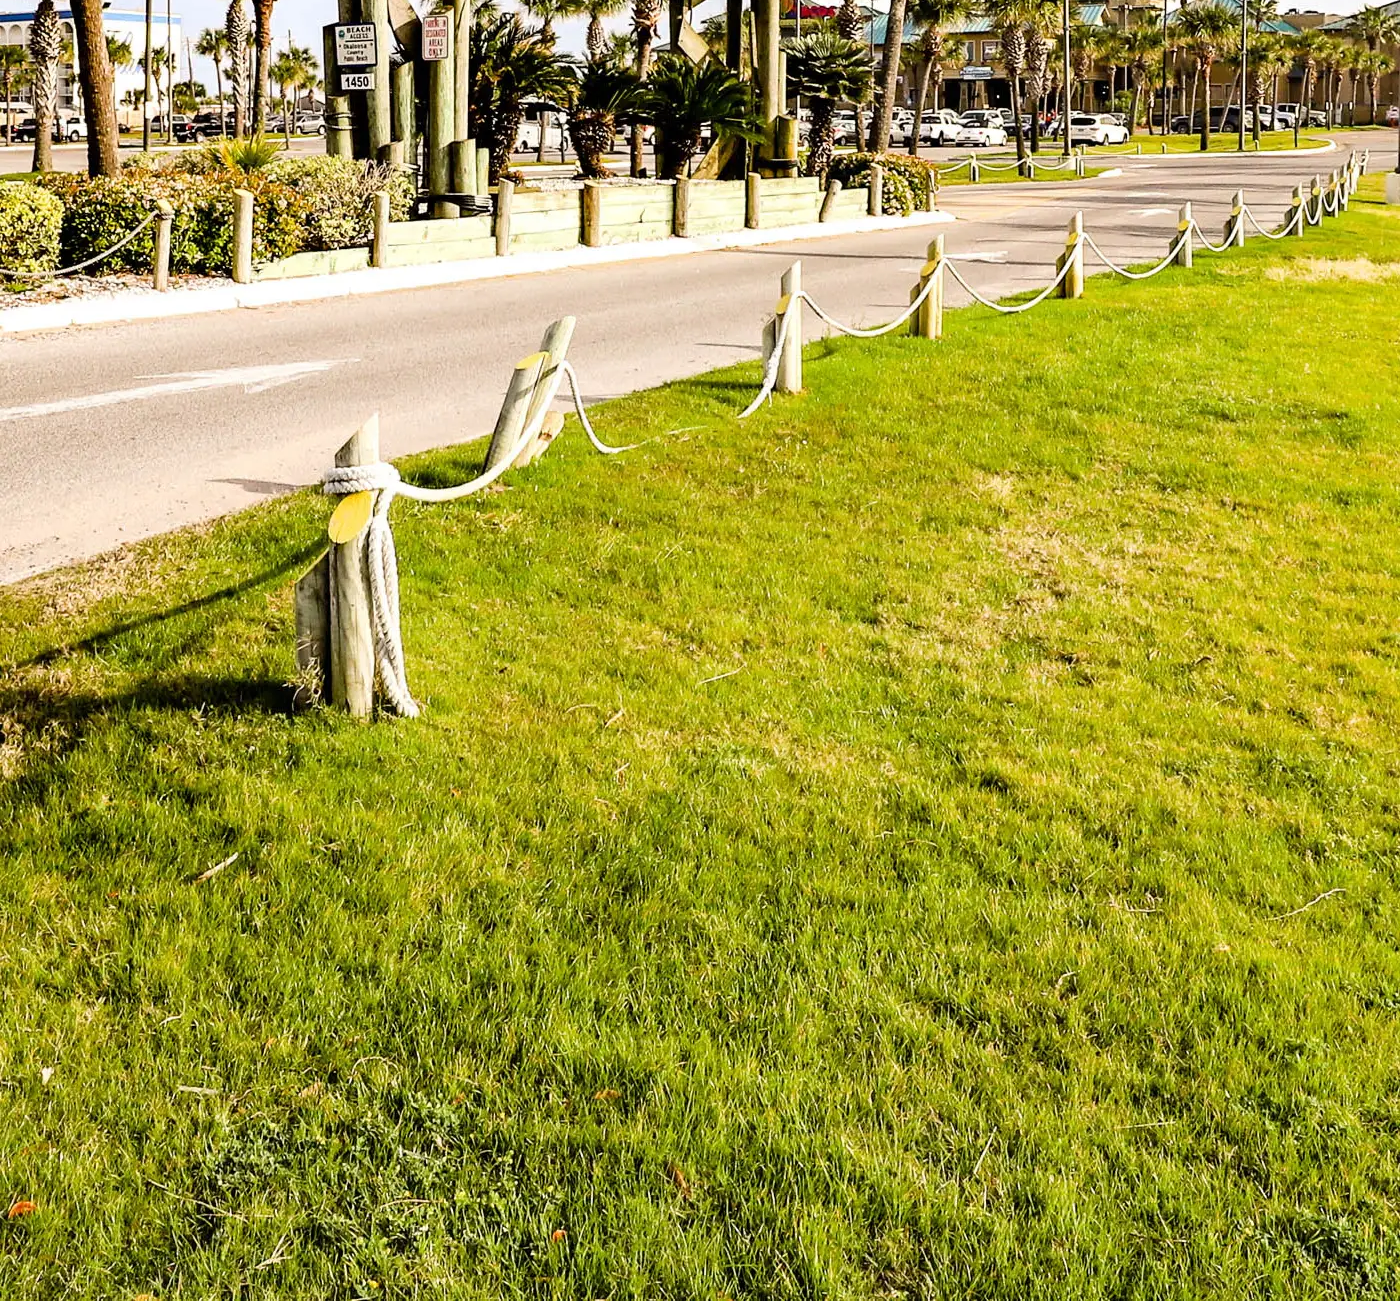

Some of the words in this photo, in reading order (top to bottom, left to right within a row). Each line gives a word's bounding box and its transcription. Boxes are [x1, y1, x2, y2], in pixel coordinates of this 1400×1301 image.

[346, 26, 371, 34] BEACH
[429, 48, 443, 56] ONLY
[345, 76, 369, 88] 1450
